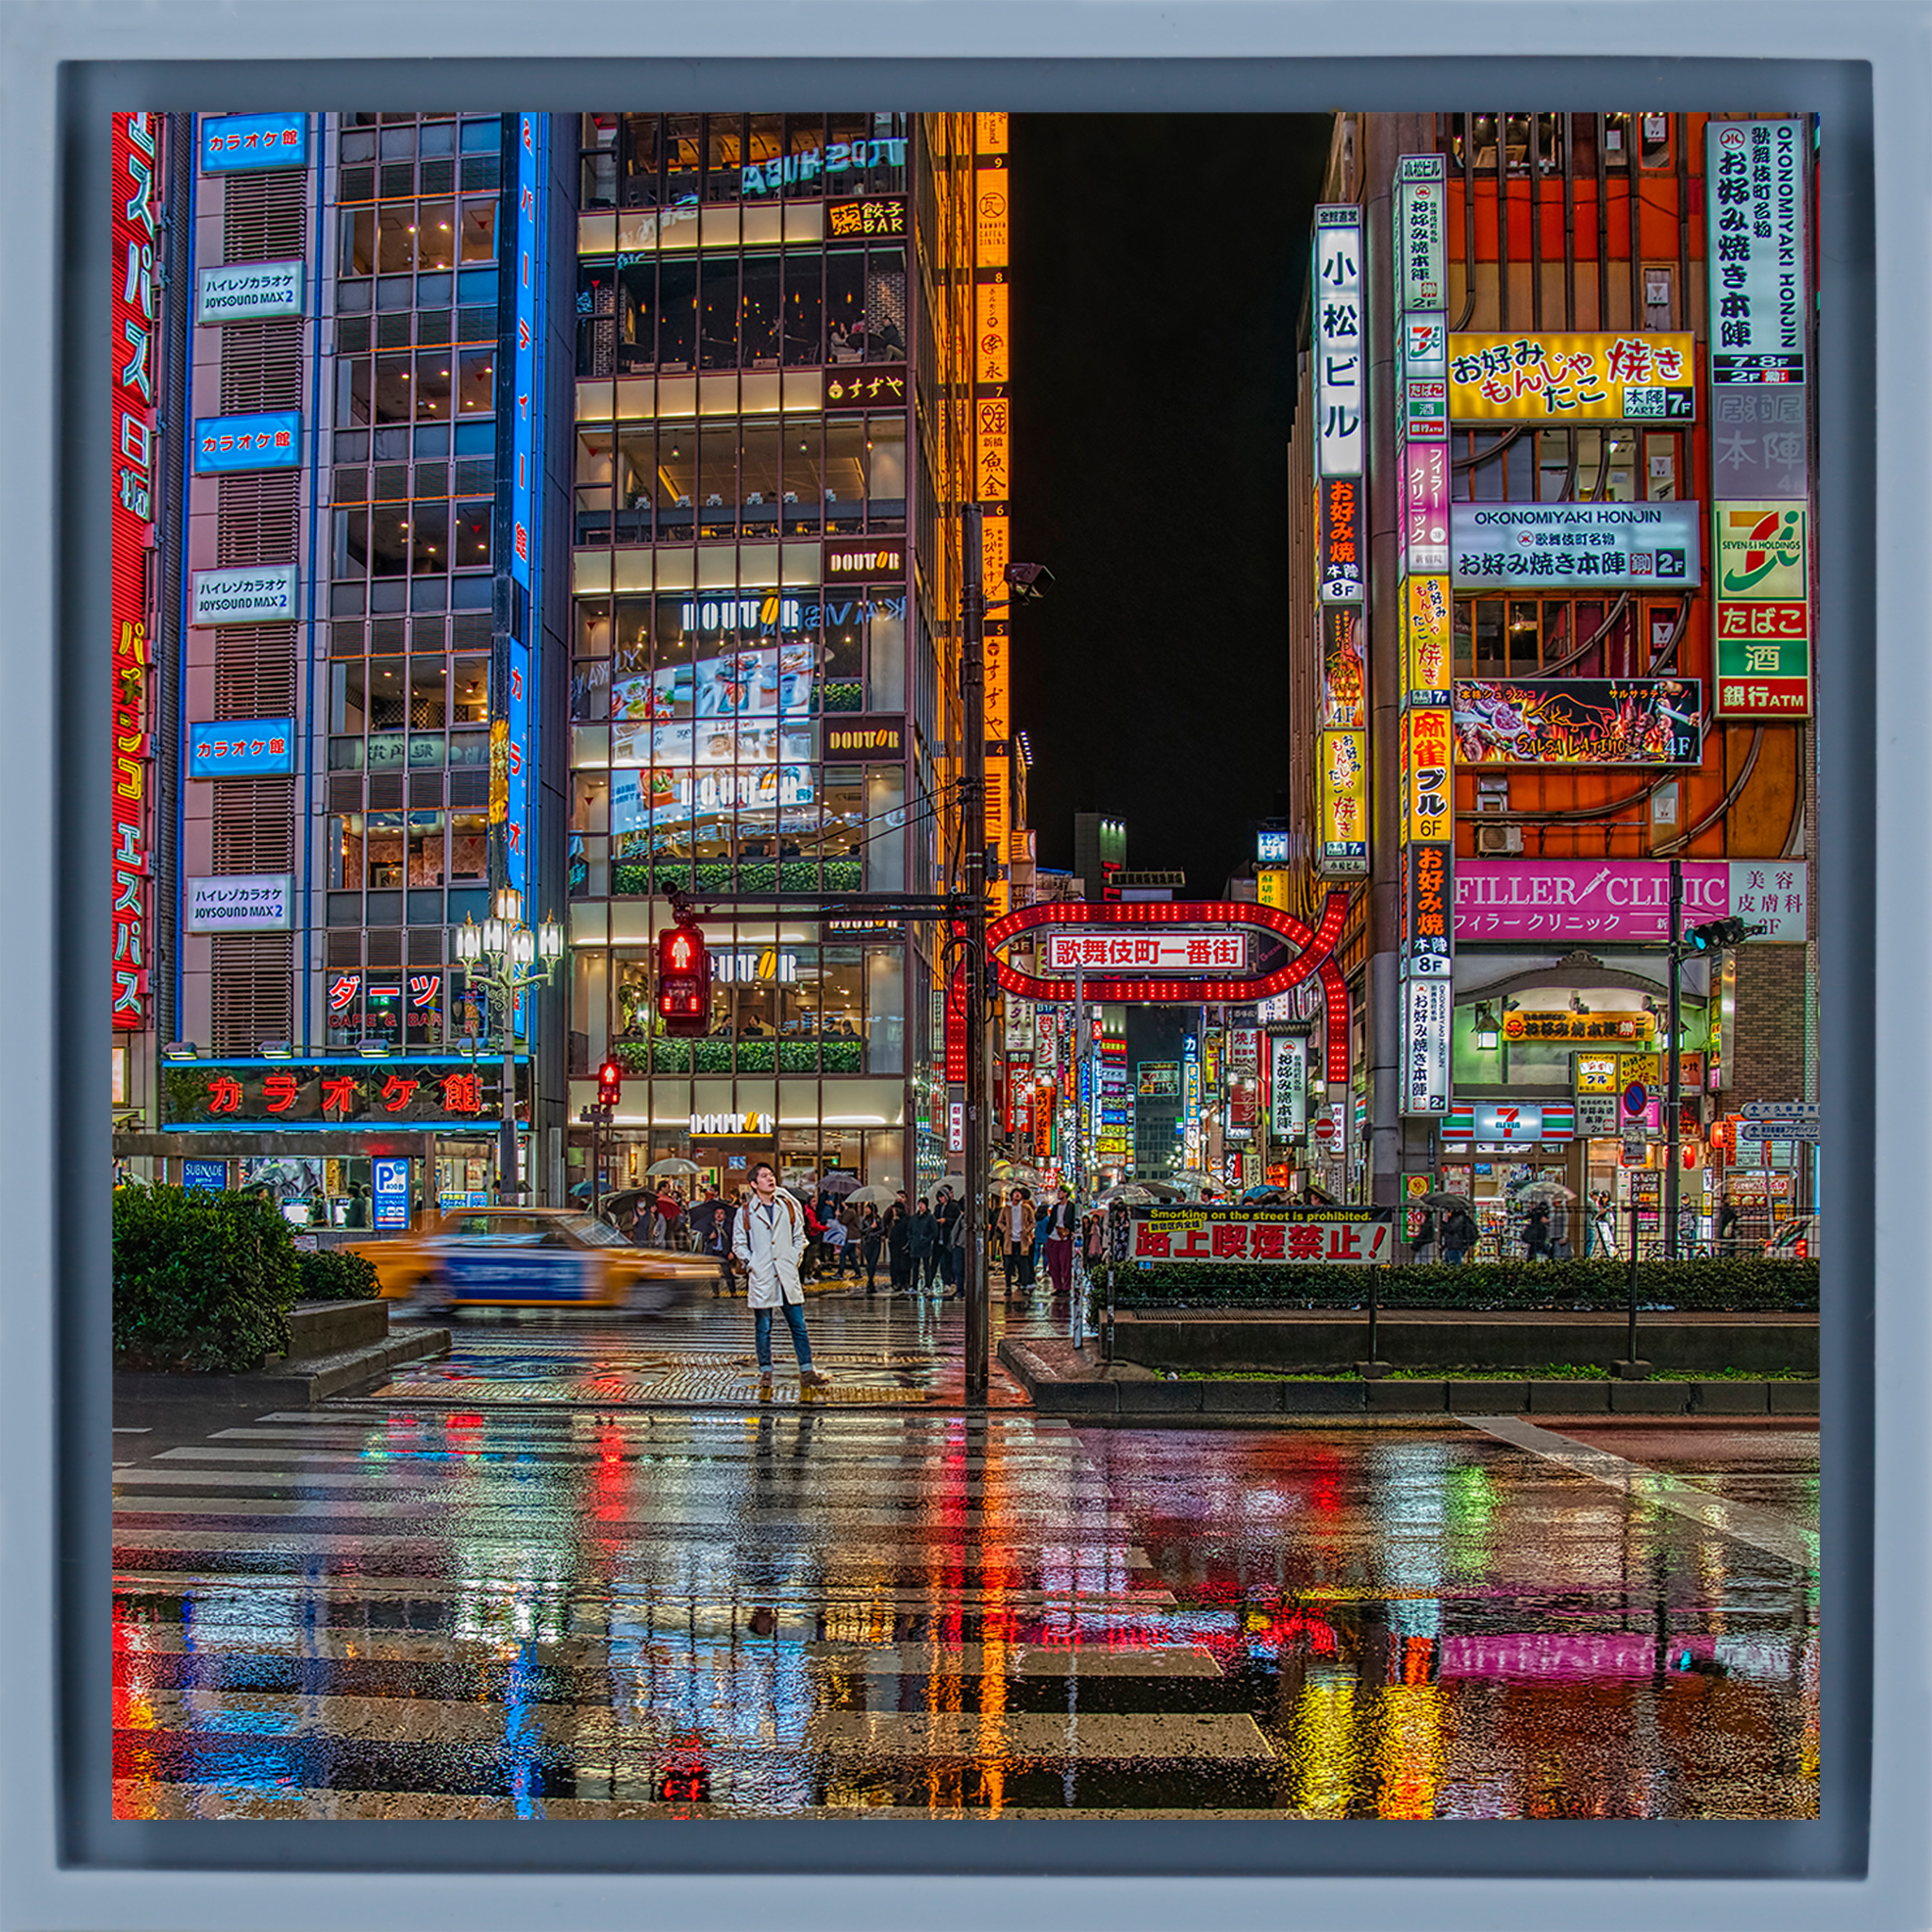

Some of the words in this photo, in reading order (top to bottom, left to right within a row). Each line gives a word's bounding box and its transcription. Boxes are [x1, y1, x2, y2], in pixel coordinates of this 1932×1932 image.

[209, 129, 298, 152] カラオケ館
[994, 157, 1004, 169] 9
[1776, 125, 1795, 267] OKONOMIYAKI
[861, 201, 905, 218] 餃子
[862, 218, 905, 234] BAR
[1717, 150, 1753, 348] お好み焼き本陣
[206, 275, 293, 291] ハイレゾカラオケ
[995, 272, 1004, 283] 8
[205, 293, 258, 309] JOYSOUND
[1412, 298, 1437, 308] 2F
[1778, 273, 1797, 349] HONJIN
[1323, 251, 1359, 440] 小松ビル
[1451, 340, 1545, 385] お好み
[1606, 339, 1684, 383] 焼き
[848, 375, 905, 399] すずや
[1480, 353, 1595, 404] もんじゃ
[1730, 371, 1761, 382] 2F
[995, 386, 1004, 397] 7
[1410, 384, 1443, 397] たばこ
[1541, 375, 1607, 413] たこ
[1625, 388, 1664, 405] 本陣
[1625, 406, 1664, 415] PART2
[1667, 391, 1692, 414] 7F
[202, 430, 291, 453] カラオケ館
[981, 451, 1007, 496] 魚金
[1430, 449, 1442, 508] フィラー
[995, 505, 1005, 516] 6
[1410, 468, 1426, 543] クリニック
[1329, 480, 1357, 563] お好み焼
[1474, 510, 1593, 525] OKONOMIYAKI
[1596, 509, 1661, 524] HONJIN
[1757, 540, 1802, 550] HOLDINGS
[830, 551, 900, 572] DOUTOR
[1457, 551, 1626, 577] お好み焼き本陣
[1657, 553, 1684, 575] 2F
[200, 579, 287, 594] ハイレゾカラオケ
[1331, 582, 1355, 597] 8F
[199, 596, 252, 611] JOYSOUND
[682, 597, 800, 631] DOUTOR
[996, 624, 1004, 635] 5
[1723, 608, 1803, 635] たばこ
[1417, 641, 1443, 686] 焼き
[1745, 645, 1781, 672] 酒
[984, 659, 1004, 739] すずや
[1433, 691, 1448, 704] 7F
[1332, 707, 1357, 723] 4F
[196, 738, 285, 758] カラオケ館
[829, 728, 900, 749] DOUTOR
[1664, 736, 1691, 757] 4F
[995, 745, 1004, 756] 4
[1332, 796, 1357, 839] 焼き
[1421, 821, 1442, 837] 6F
[1417, 847, 1444, 935] お好み焼
[1454, 876, 1577, 906] FILLER
[1746, 870, 1794, 891] 美容
[195, 889, 282, 902] ハイレゾカラオケ
[1737, 893, 1804, 914] 皮膚科
[114, 822, 142, 1015] エスパス
[194, 906, 247, 919] JOYSOUND
[1454, 914, 1522, 932] フィラー
[1527, 914, 1621, 932] クリニック
[1057, 939, 1239, 965] 歌舞伎町一番街
[1418, 957, 1442, 973] 8F
[329, 974, 441, 1010] ダーツ
[329, 1014, 376, 1027] CAFE
[385, 1013, 397, 1027] &
[408, 1012, 442, 1026] BAR
[208, 1074, 481, 1113] カラオケ館
[378, 1166, 394, 1191] P
[1150, 1209, 1208, 1222] Smorking
[1210, 1211, 1226, 1220] on
[1229, 1210, 1250, 1220] the
[1252, 1211, 1291, 1221] street
[1292, 1211, 1304, 1221] is
[1307, 1211, 1373, 1223] prohibited.
